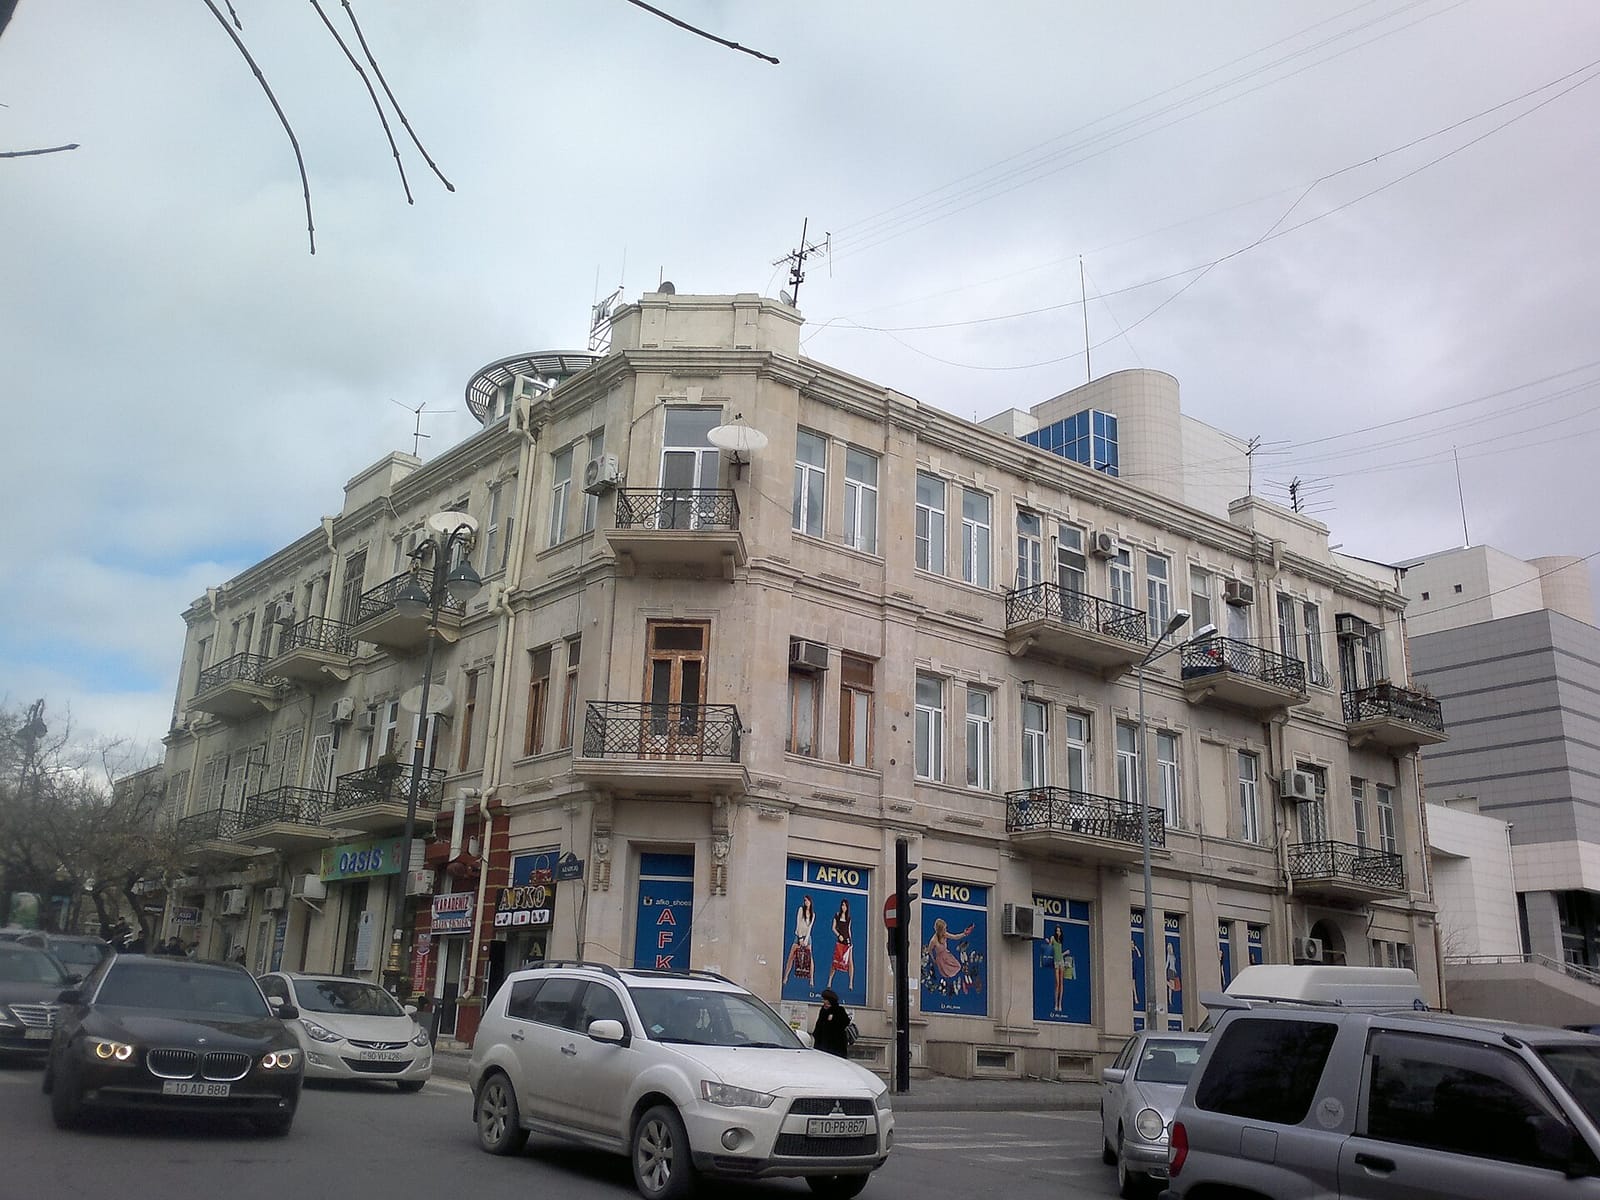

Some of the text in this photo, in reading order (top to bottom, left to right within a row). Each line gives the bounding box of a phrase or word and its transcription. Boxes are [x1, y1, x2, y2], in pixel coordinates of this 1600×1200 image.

[816, 866, 859, 886] AFKO
[499, 886, 545, 910] AFKO
[931, 883, 970, 902] AFKO
[176, 1083, 188, 1094] 10
